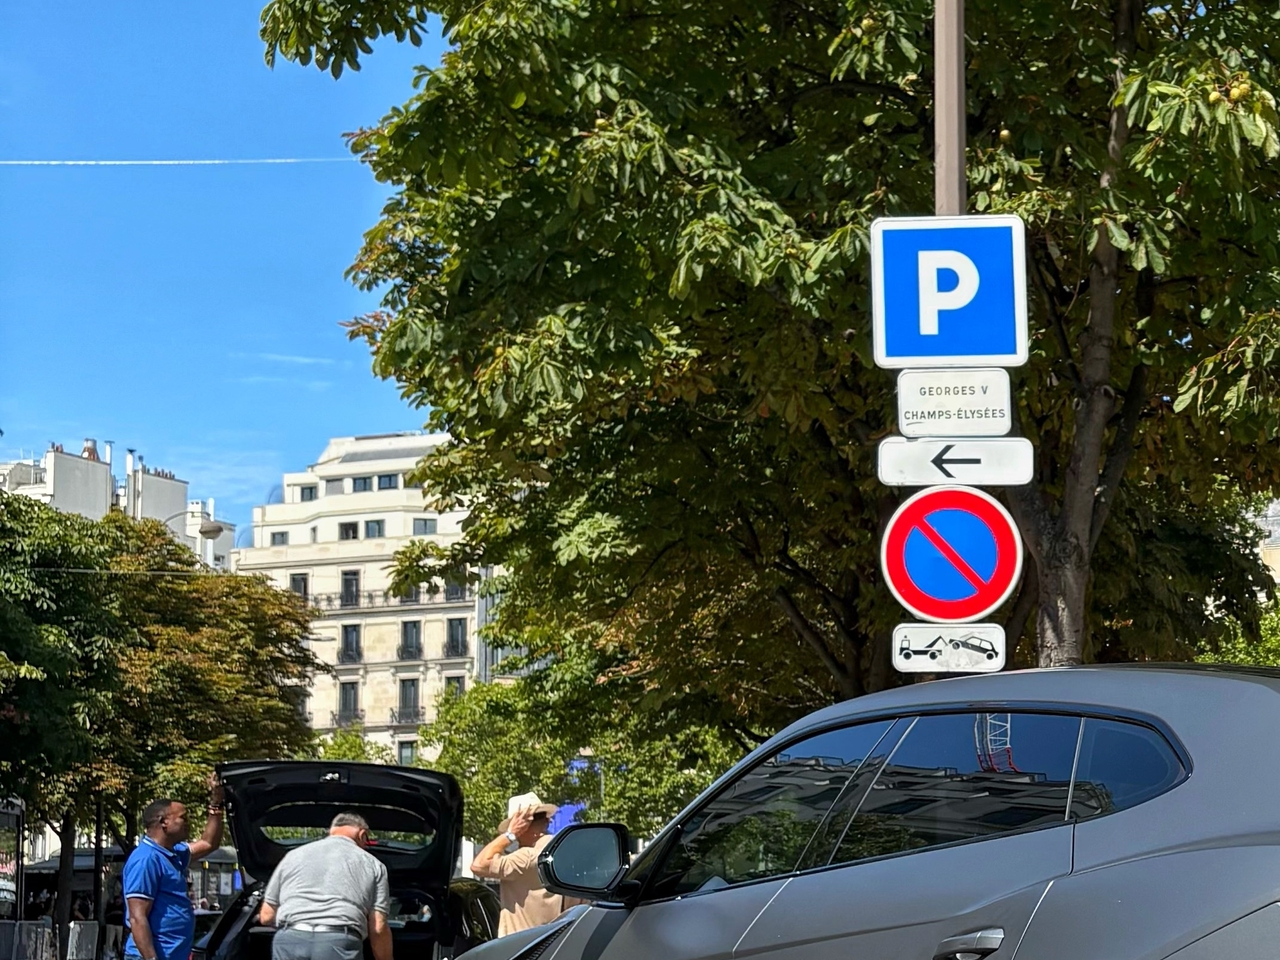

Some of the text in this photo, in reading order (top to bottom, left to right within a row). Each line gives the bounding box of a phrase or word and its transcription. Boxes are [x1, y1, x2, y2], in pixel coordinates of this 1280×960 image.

[918, 250, 980, 335] P
[919, 385, 989, 397] GEORGES V
[904, 407, 1006, 420] CHAMPS-ÉLYSÉES
